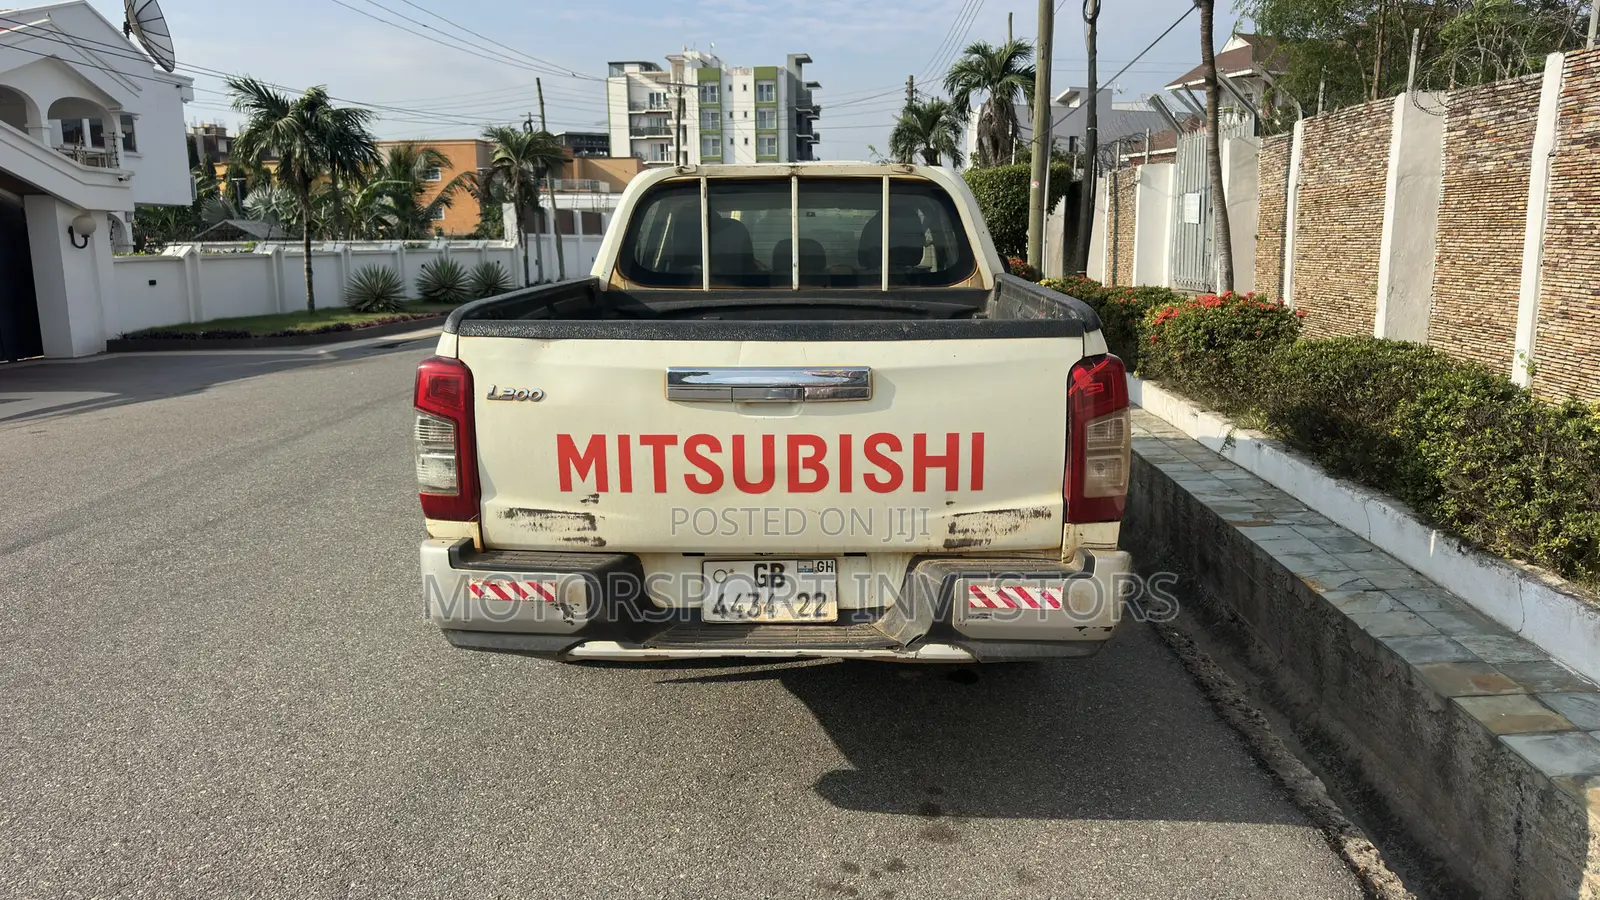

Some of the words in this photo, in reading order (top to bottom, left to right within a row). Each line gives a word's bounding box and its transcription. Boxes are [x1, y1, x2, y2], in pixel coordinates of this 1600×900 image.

[487, 384, 544, 402] L200
[556, 432, 985, 494] MITSUBISHI
[753, 563, 786, 588] GB
[817, 560, 834, 573] GH
[712, 592, 777, 619] 4434
[796, 592, 828, 618] 22
